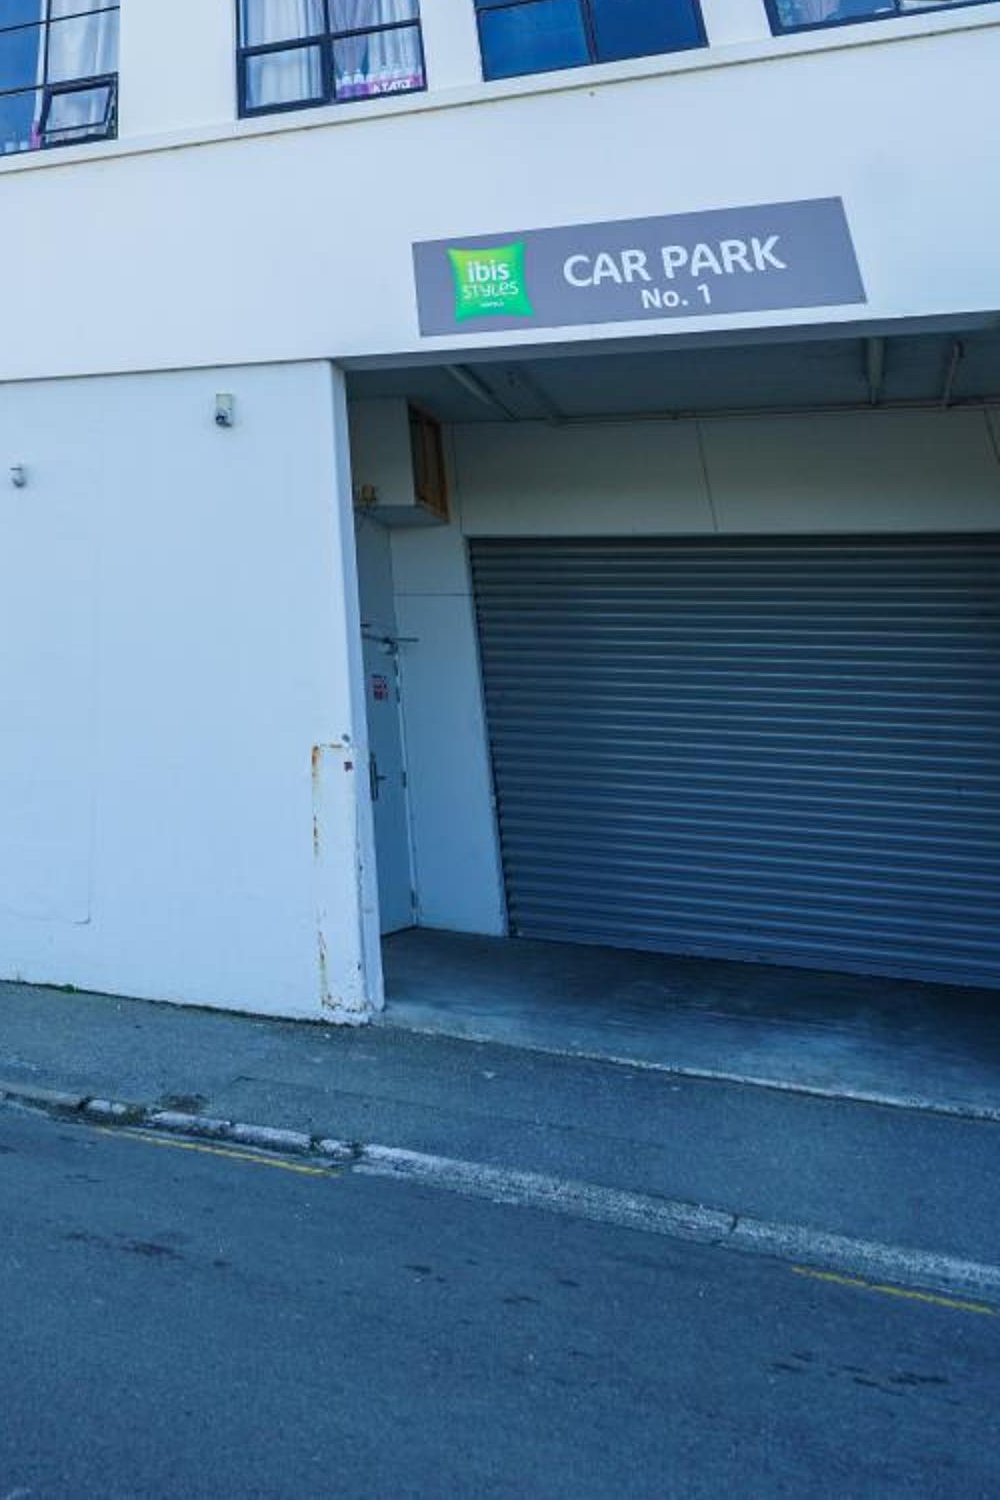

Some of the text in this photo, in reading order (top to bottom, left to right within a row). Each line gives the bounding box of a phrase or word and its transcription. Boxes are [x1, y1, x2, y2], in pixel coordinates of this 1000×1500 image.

[465, 259, 510, 283] ibis
[563, 235, 787, 287] CAR PARK
[641, 283, 711, 309] No. 1
